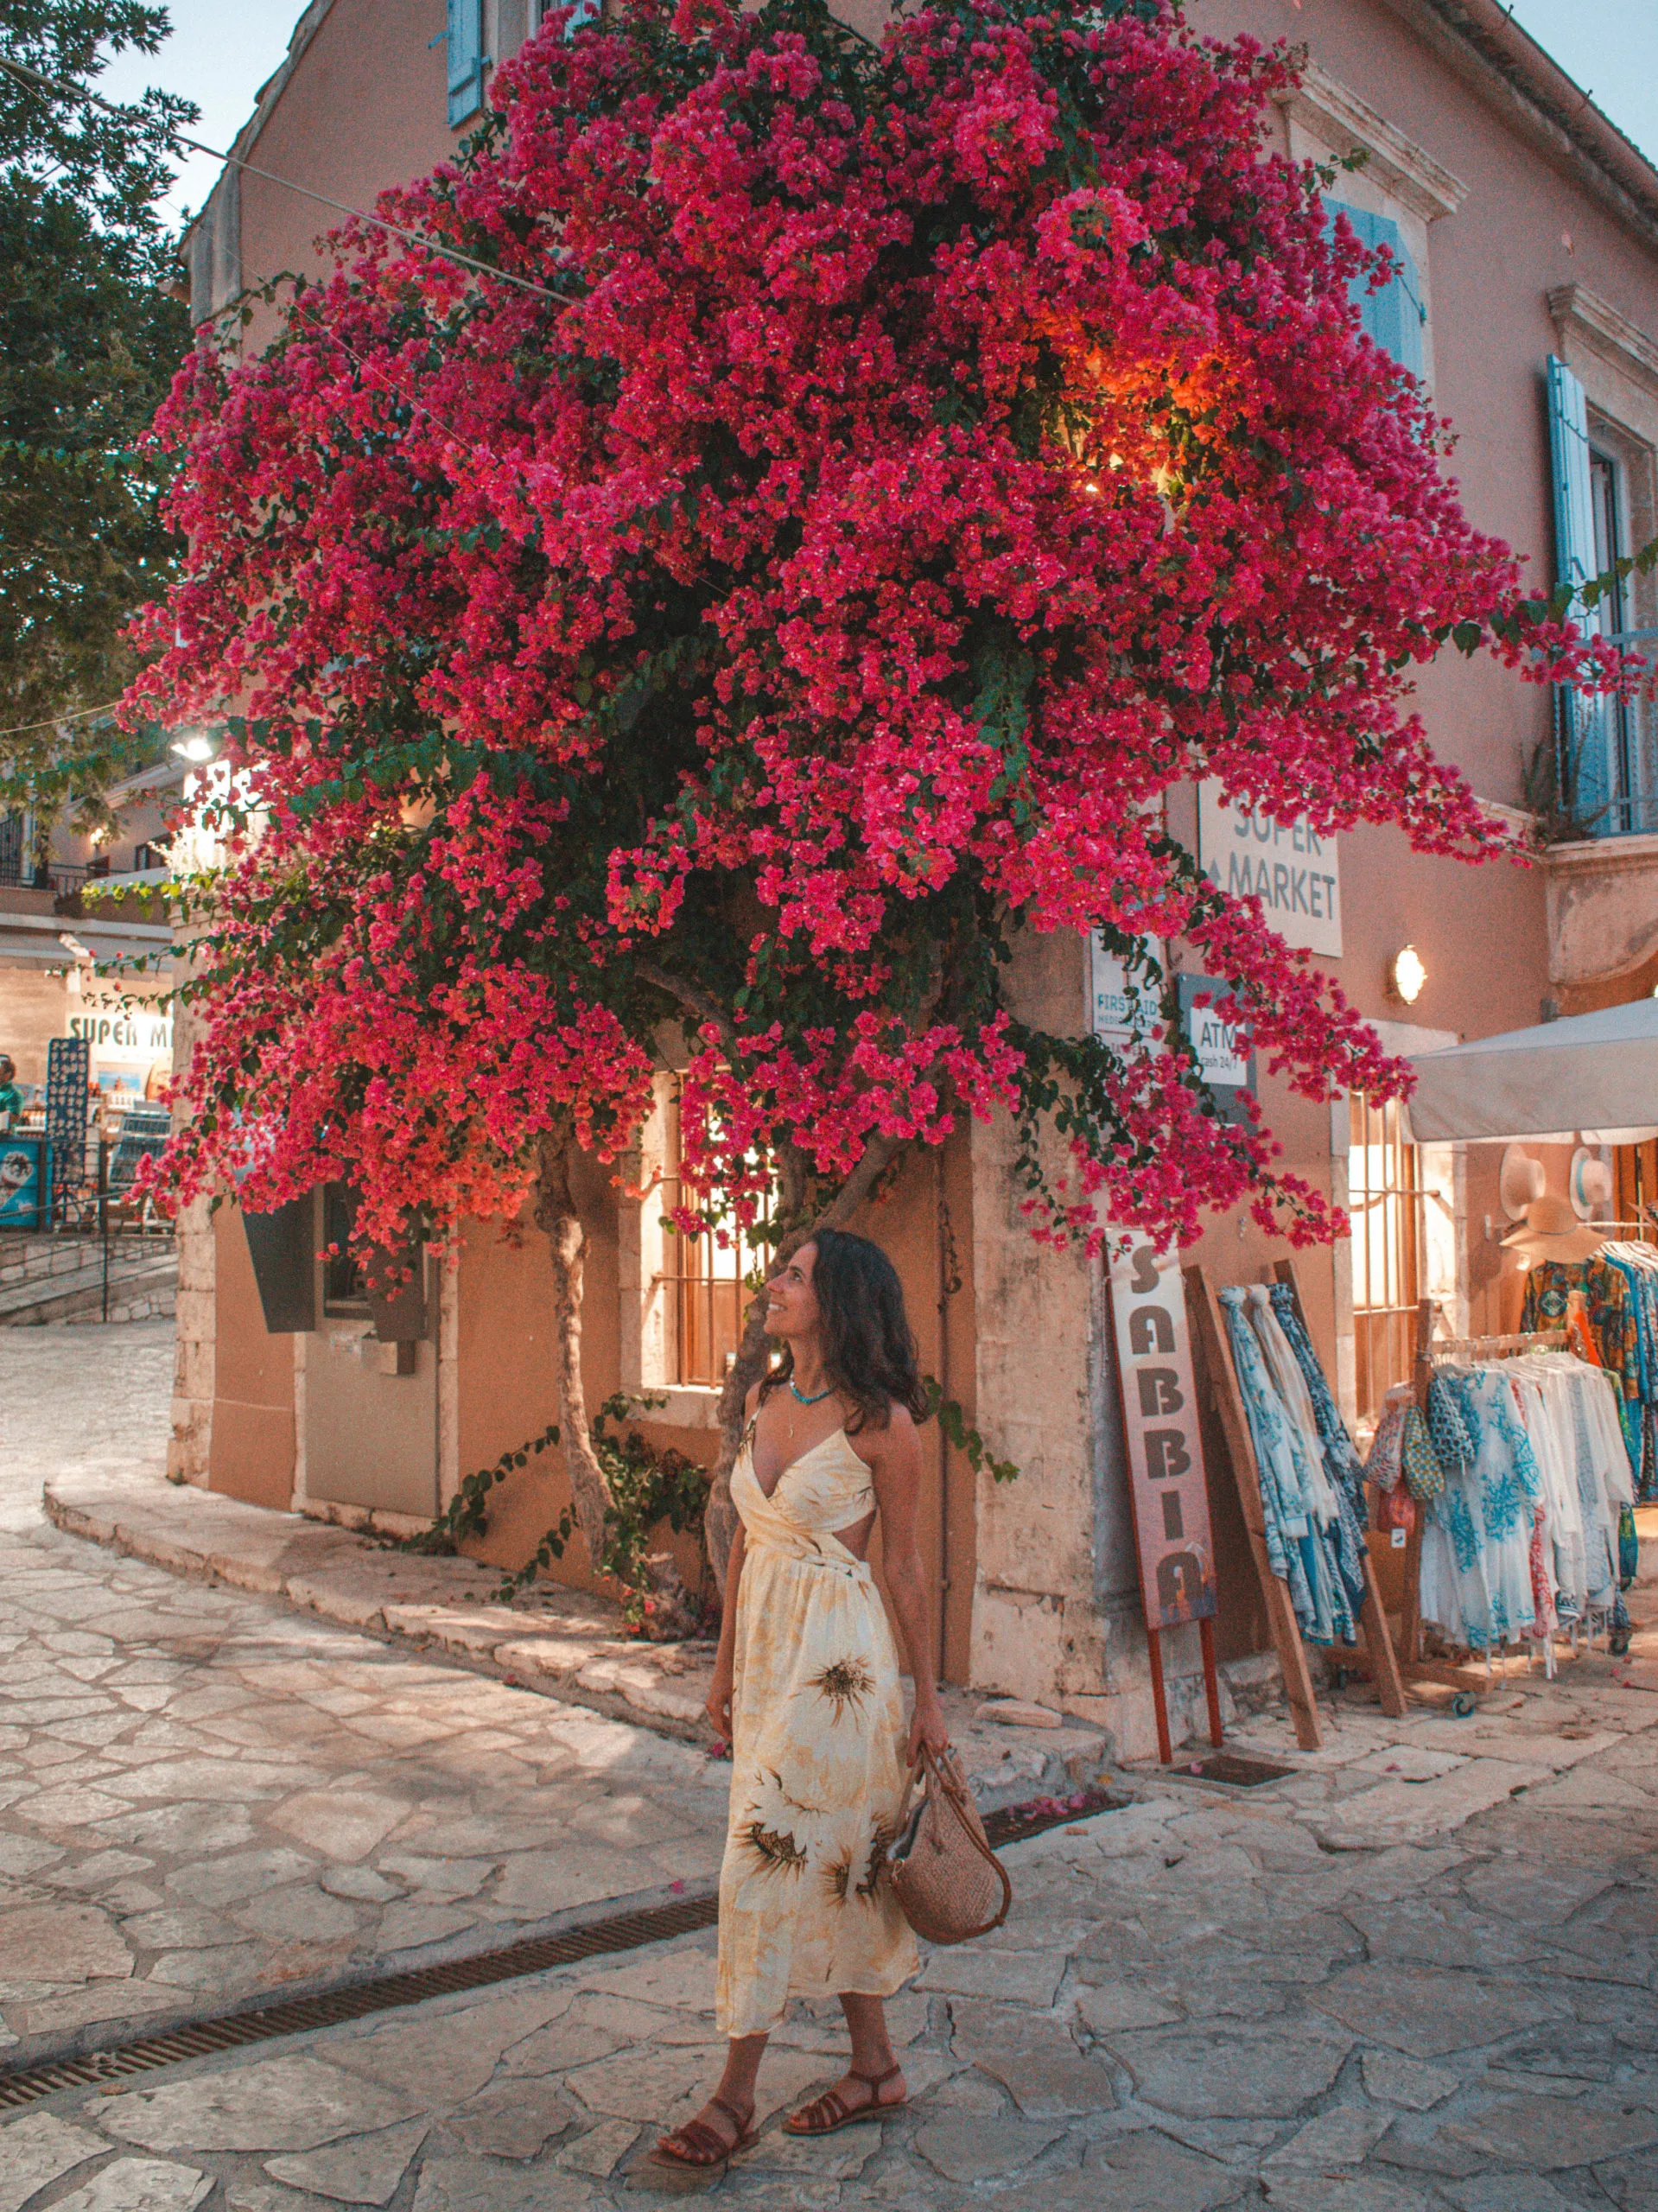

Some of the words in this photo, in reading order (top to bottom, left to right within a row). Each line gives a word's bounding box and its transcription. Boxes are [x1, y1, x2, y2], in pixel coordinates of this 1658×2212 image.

[1234, 790, 1322, 856] SUPER
[1229, 850, 1337, 920] MARKET
[70, 1018, 137, 1046] SUPER
[150, 1022, 173, 1047] M
[1201, 1022, 1238, 1048] ATM
[1129, 1244, 1204, 1605] SABBIA
